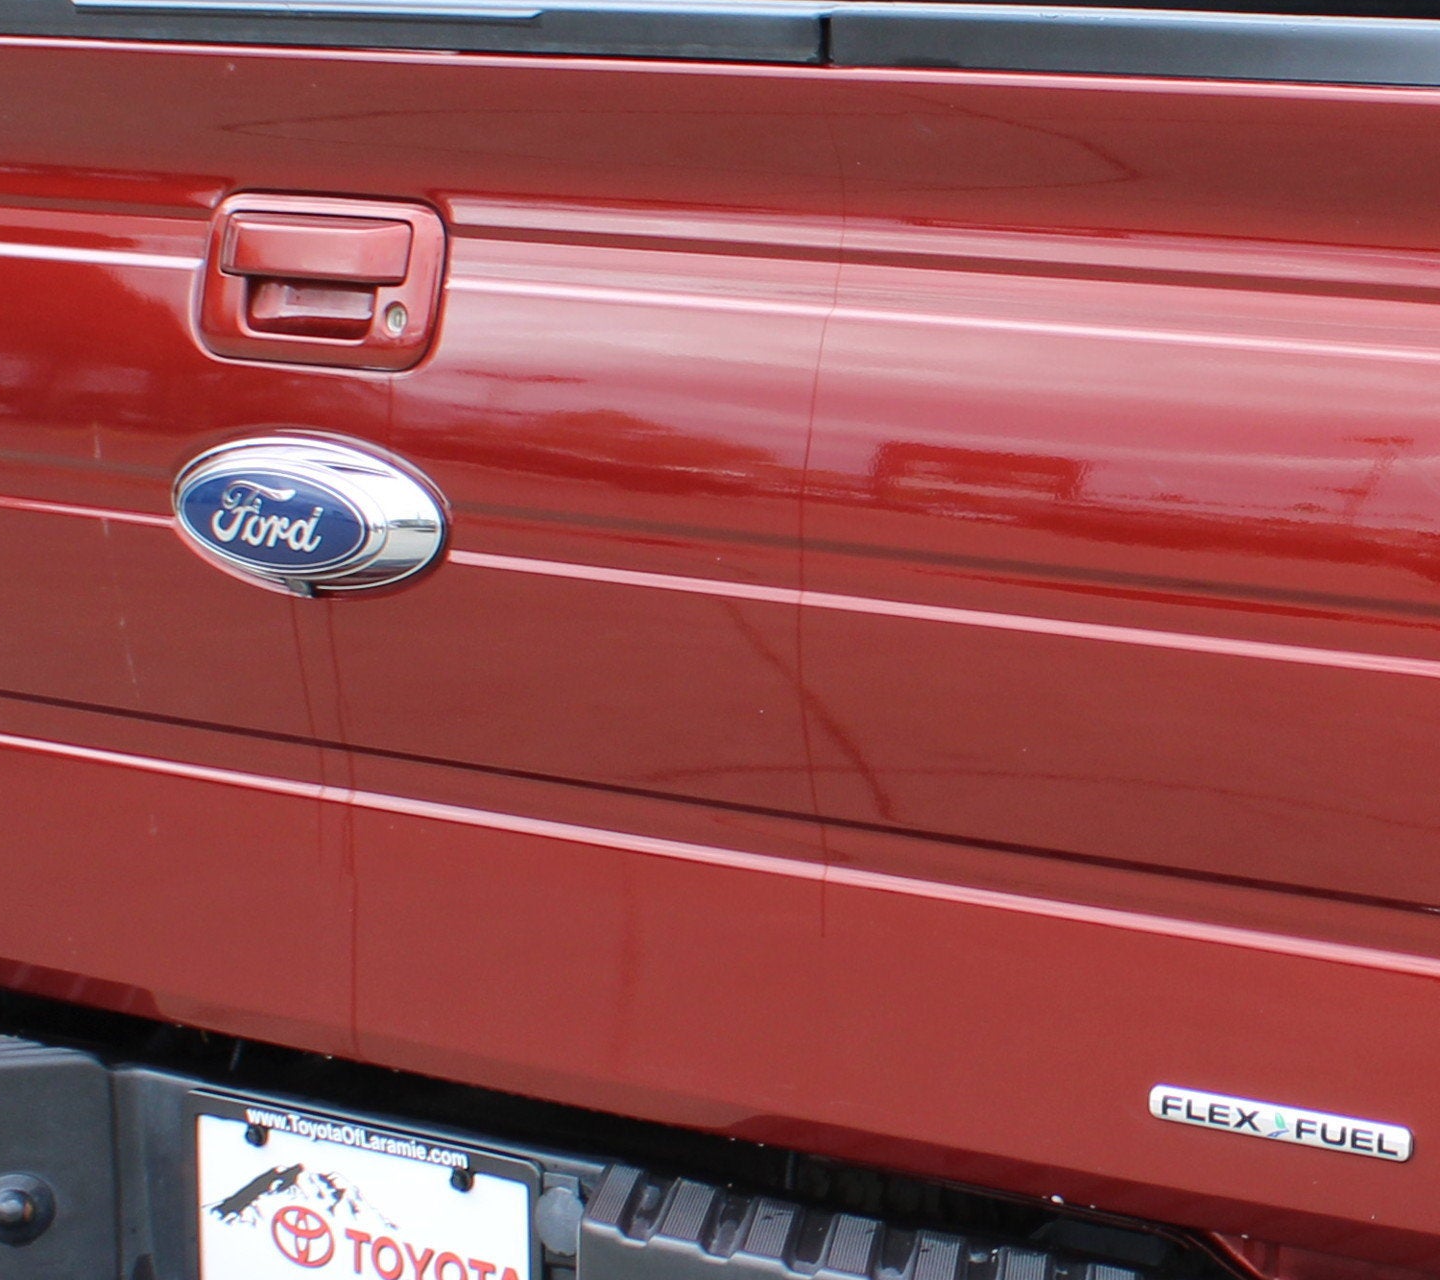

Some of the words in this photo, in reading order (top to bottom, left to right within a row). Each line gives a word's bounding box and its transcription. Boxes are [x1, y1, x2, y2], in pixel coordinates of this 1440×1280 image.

[211, 479, 324, 553] Ford
[245, 1107, 469, 1170] www.ToyotaOfLaramie.com
[1161, 1093, 1261, 1133] FLEX
[1295, 1118, 1400, 1158] FUEL
